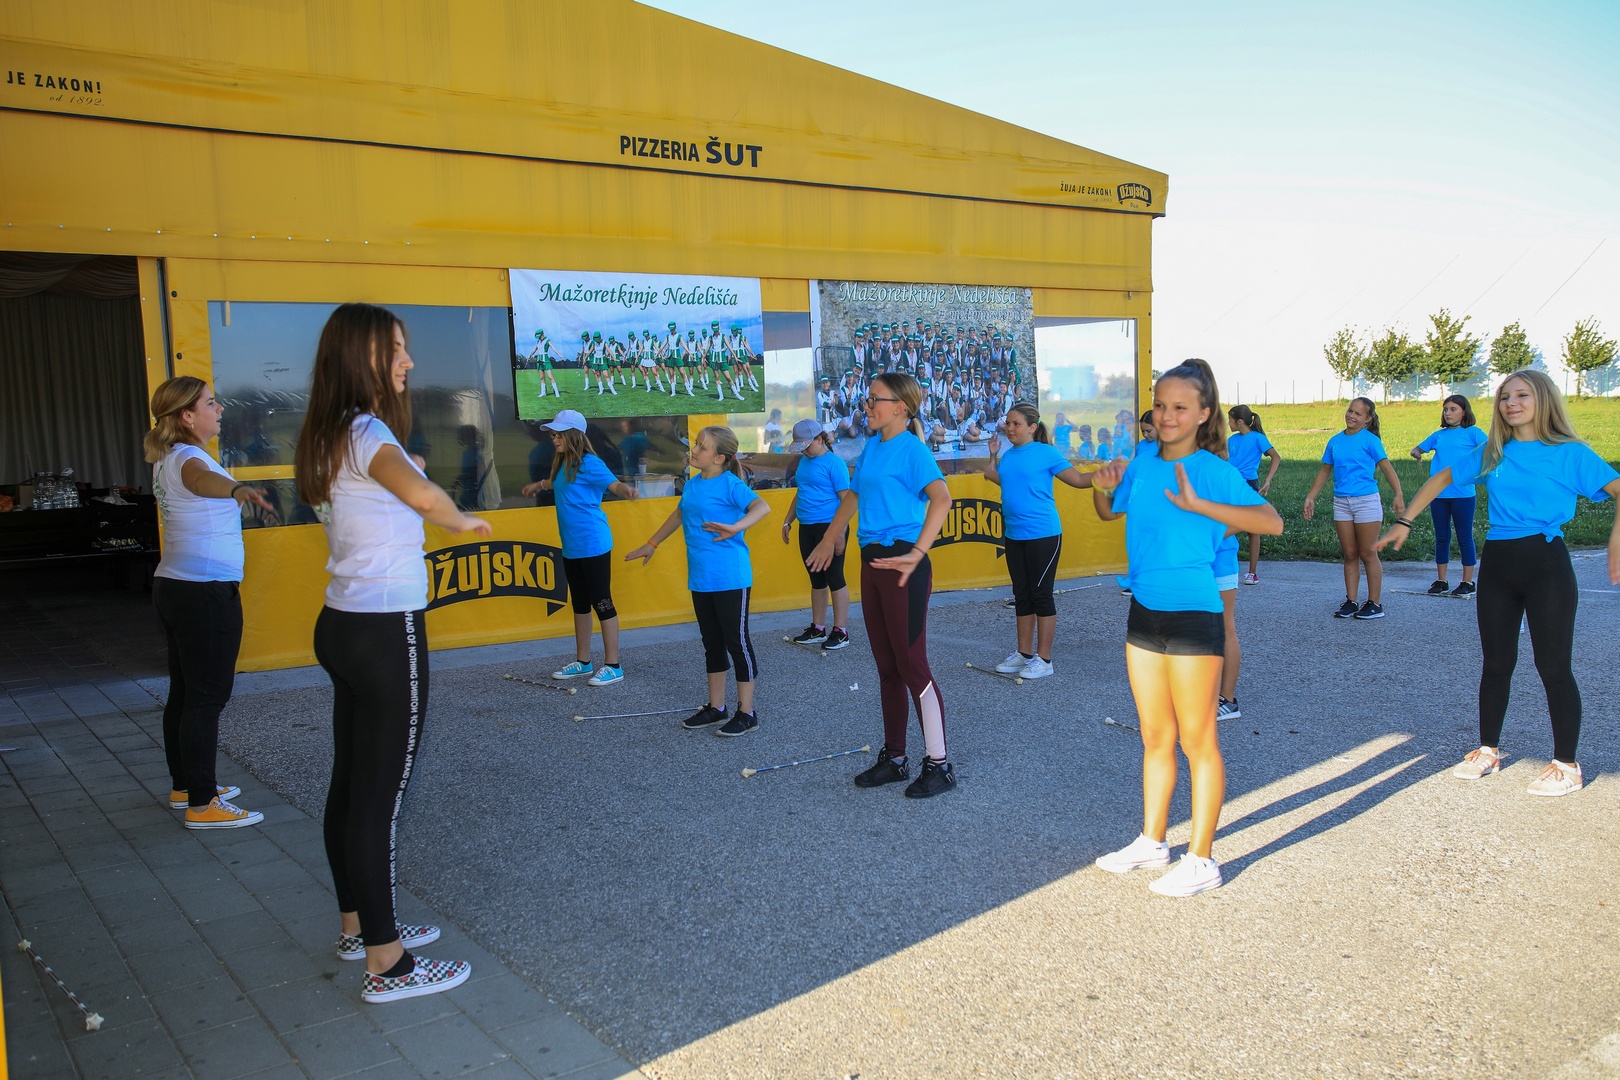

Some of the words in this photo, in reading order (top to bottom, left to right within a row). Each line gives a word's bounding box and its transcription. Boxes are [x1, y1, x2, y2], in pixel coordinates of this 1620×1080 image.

[7, 70, 26, 85] JE
[34, 74, 101, 94] ZAKON!
[49, 94, 63, 102] od
[620, 135, 700, 162] PIZZERIA
[705, 136, 763, 167] ŠUT
[1060, 181, 1076, 193] ŽUJA
[1078, 185, 1085, 194] JE
[1088, 186, 1112, 196] ZAKON!
[1119, 184, 1149, 200] Ožujsko
[539, 283, 658, 310] Mažoretkinje
[662, 286, 738, 306] Nedelišća
[839, 281, 945, 308] Mažoretkinje
[948, 284, 1018, 304] Nedelišća
[934, 502, 1003, 541] ujsko
[407, 634, 416, 645] OF
[408, 646, 418, 679] NOTHING
[402, 754, 413, 779] AFRAID
